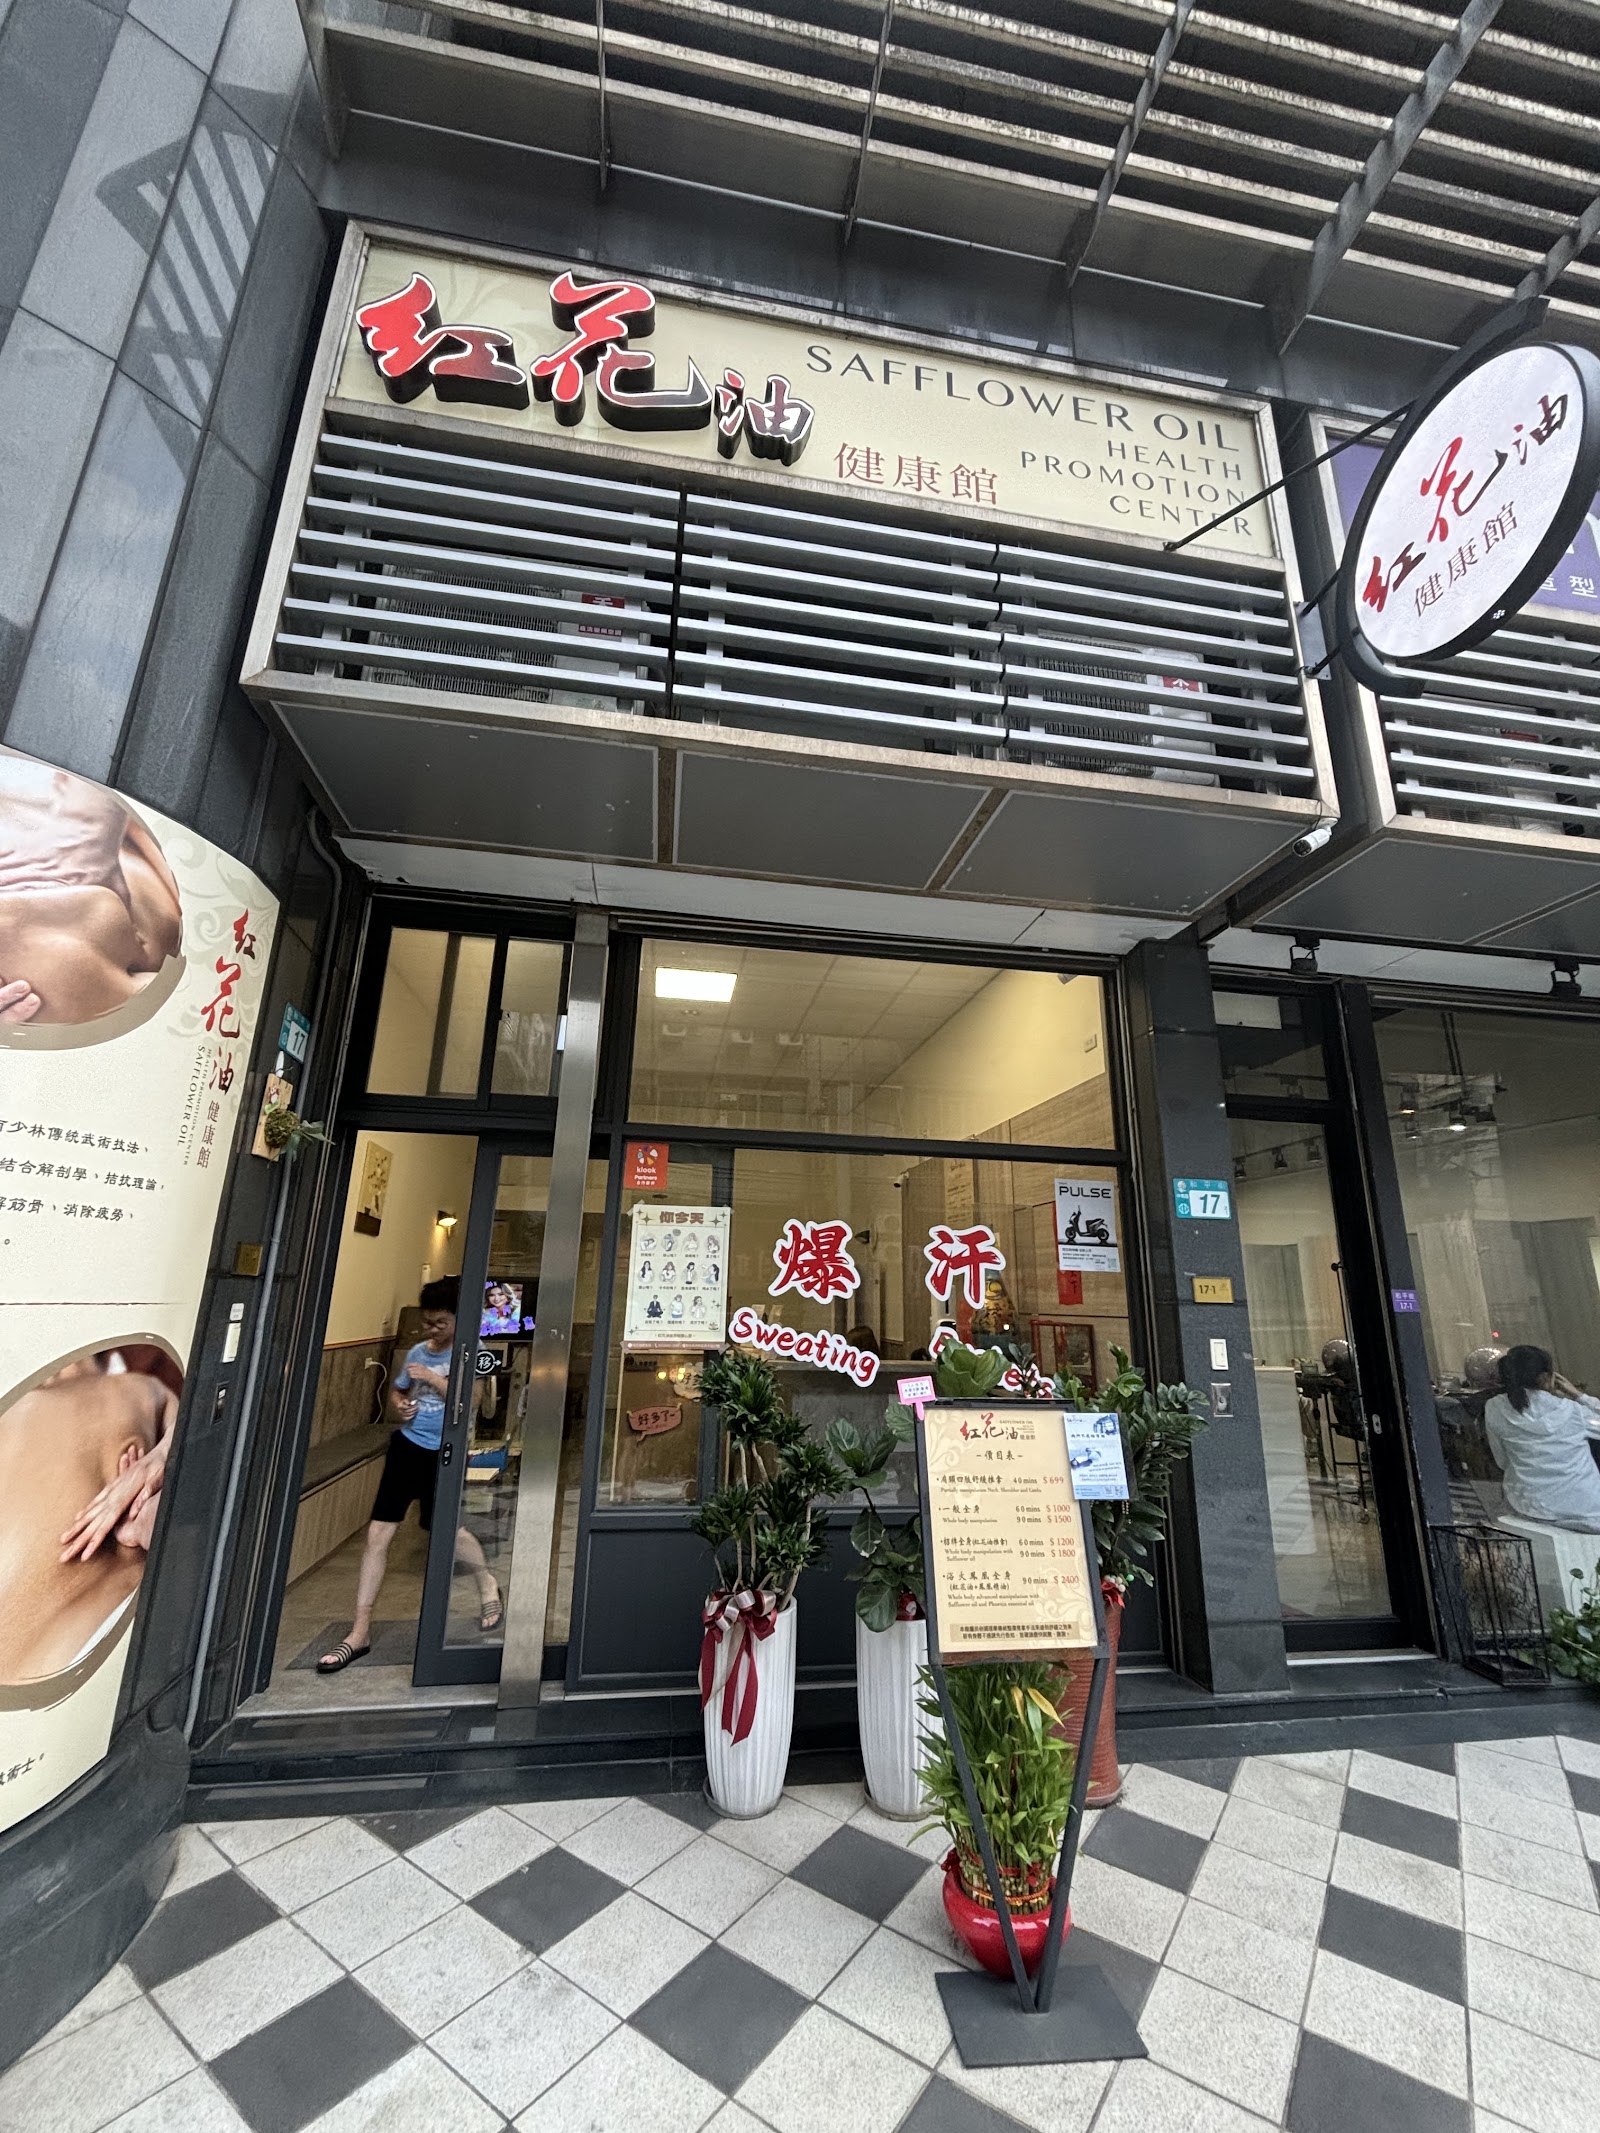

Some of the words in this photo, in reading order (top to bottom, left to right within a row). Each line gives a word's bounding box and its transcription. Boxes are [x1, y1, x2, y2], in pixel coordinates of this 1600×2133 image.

[806, 344, 1133, 432] SAFFLOWER
[1153, 412, 1240, 453] OIL
[833, 442, 999, 506] 健康館
[1021, 450, 1245, 506] PROMOTION
[1107, 438, 1242, 481] HEALTH
[1413, 500, 1518, 618] 健康館
[293, 1030, 306, 1056] 17
[183, 1045, 206, 1121] SAFFLOWER
[191, 1081, 205, 1131] PROMOTION
[177, 1124, 189, 1147] OIL
[183, 1132, 195, 1166] CENTER
[196, 1100, 220, 1169] 健康館
[1059, 1186, 1111, 1199] PULSE
[1199, 1193, 1221, 1215] 17
[773, 1223, 857, 1300] 爆
[927, 1228, 1002, 1305] 汗
[478, 1355, 492, 1370] 移
[733, 1311, 876, 1383] Sweating
